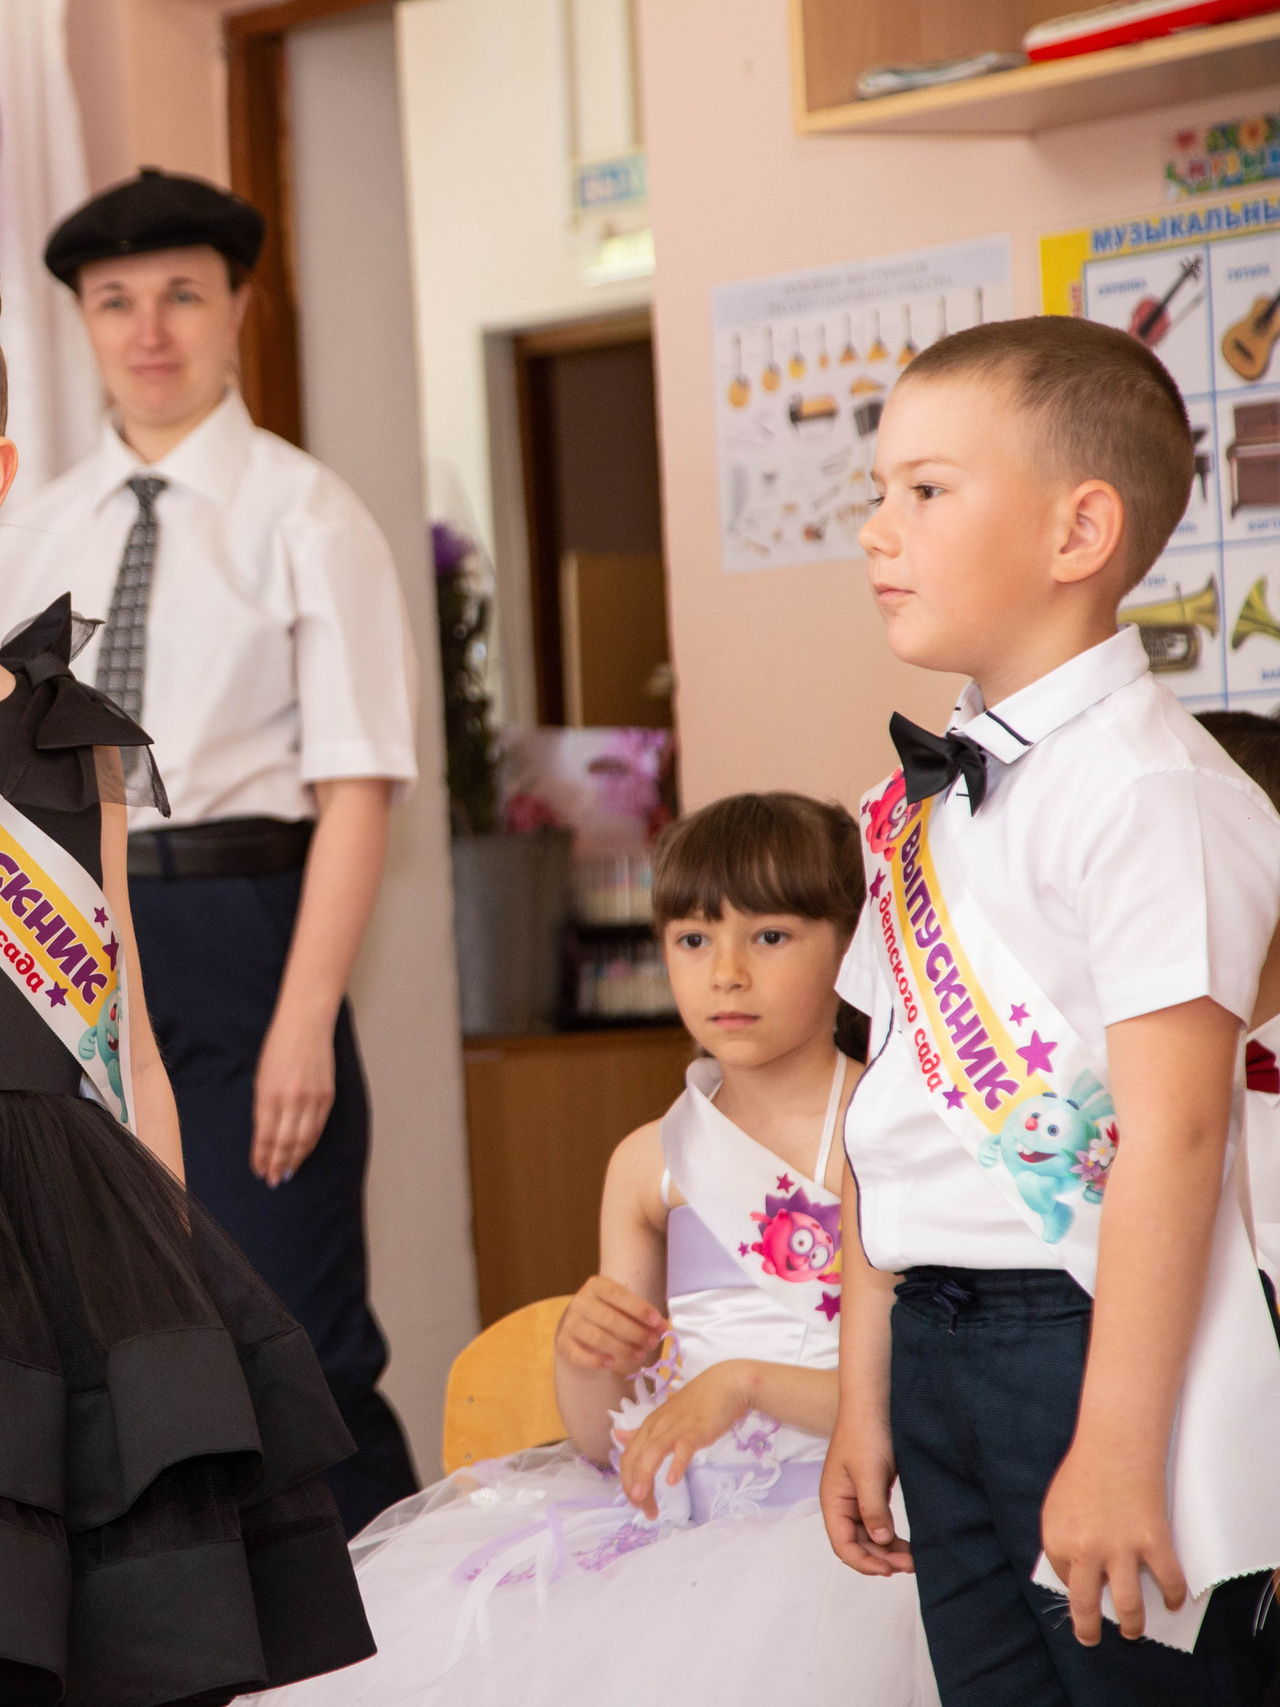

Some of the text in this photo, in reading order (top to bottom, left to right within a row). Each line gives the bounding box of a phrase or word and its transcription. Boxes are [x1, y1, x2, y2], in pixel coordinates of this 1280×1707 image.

[879, 891, 945, 1094] детского сада
[900, 820, 1021, 1111] ВЫПУСКНИК
